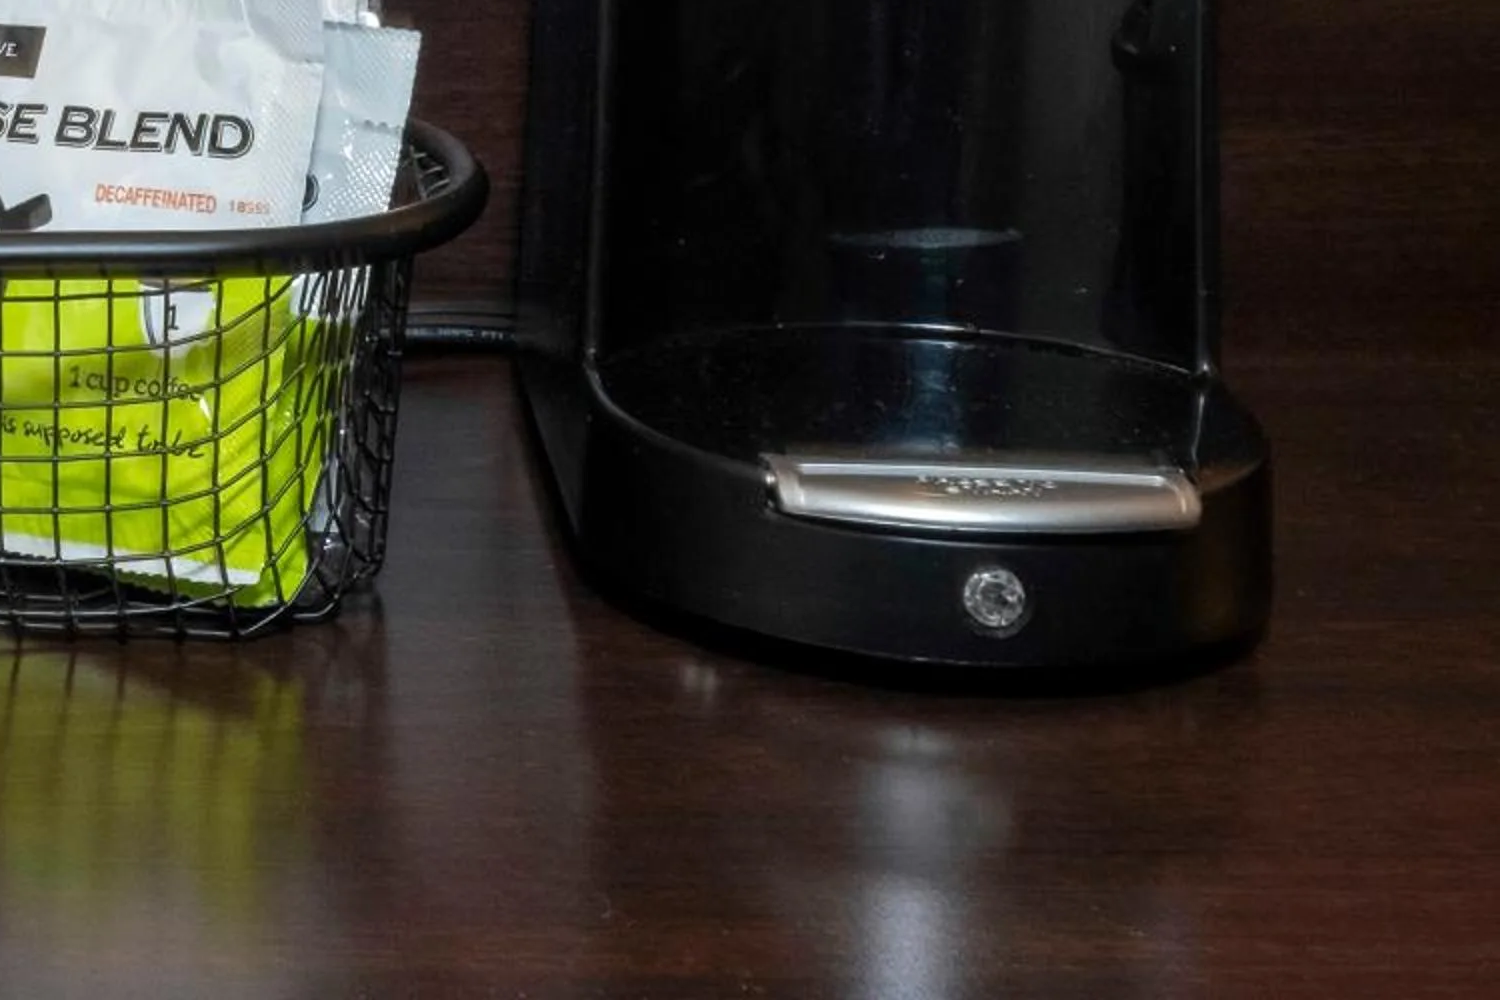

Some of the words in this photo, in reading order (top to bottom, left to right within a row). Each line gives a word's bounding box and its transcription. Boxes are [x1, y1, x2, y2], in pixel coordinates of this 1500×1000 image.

[55, 104, 256, 159] BLEND
[95, 183, 217, 214] DECAFFEINATED
[70, 365, 80, 388] 1
